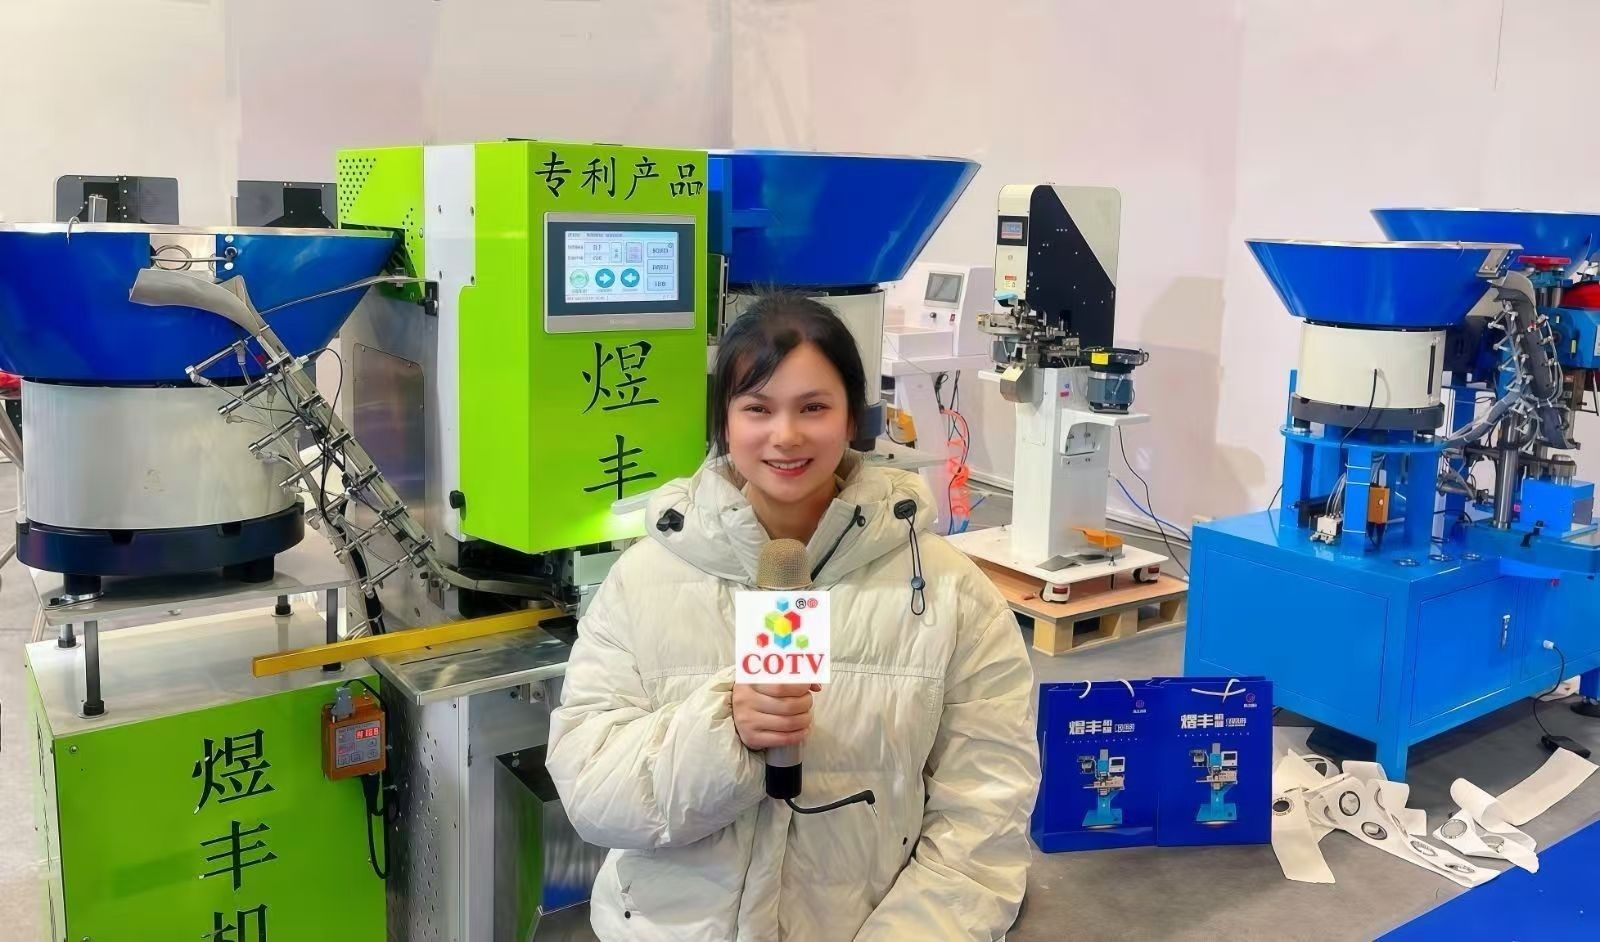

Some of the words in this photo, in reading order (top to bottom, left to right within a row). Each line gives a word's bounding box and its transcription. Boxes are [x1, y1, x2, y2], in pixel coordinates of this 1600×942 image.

[534, 151, 704, 200] 专利产品
[742, 653, 825, 675] COTV
